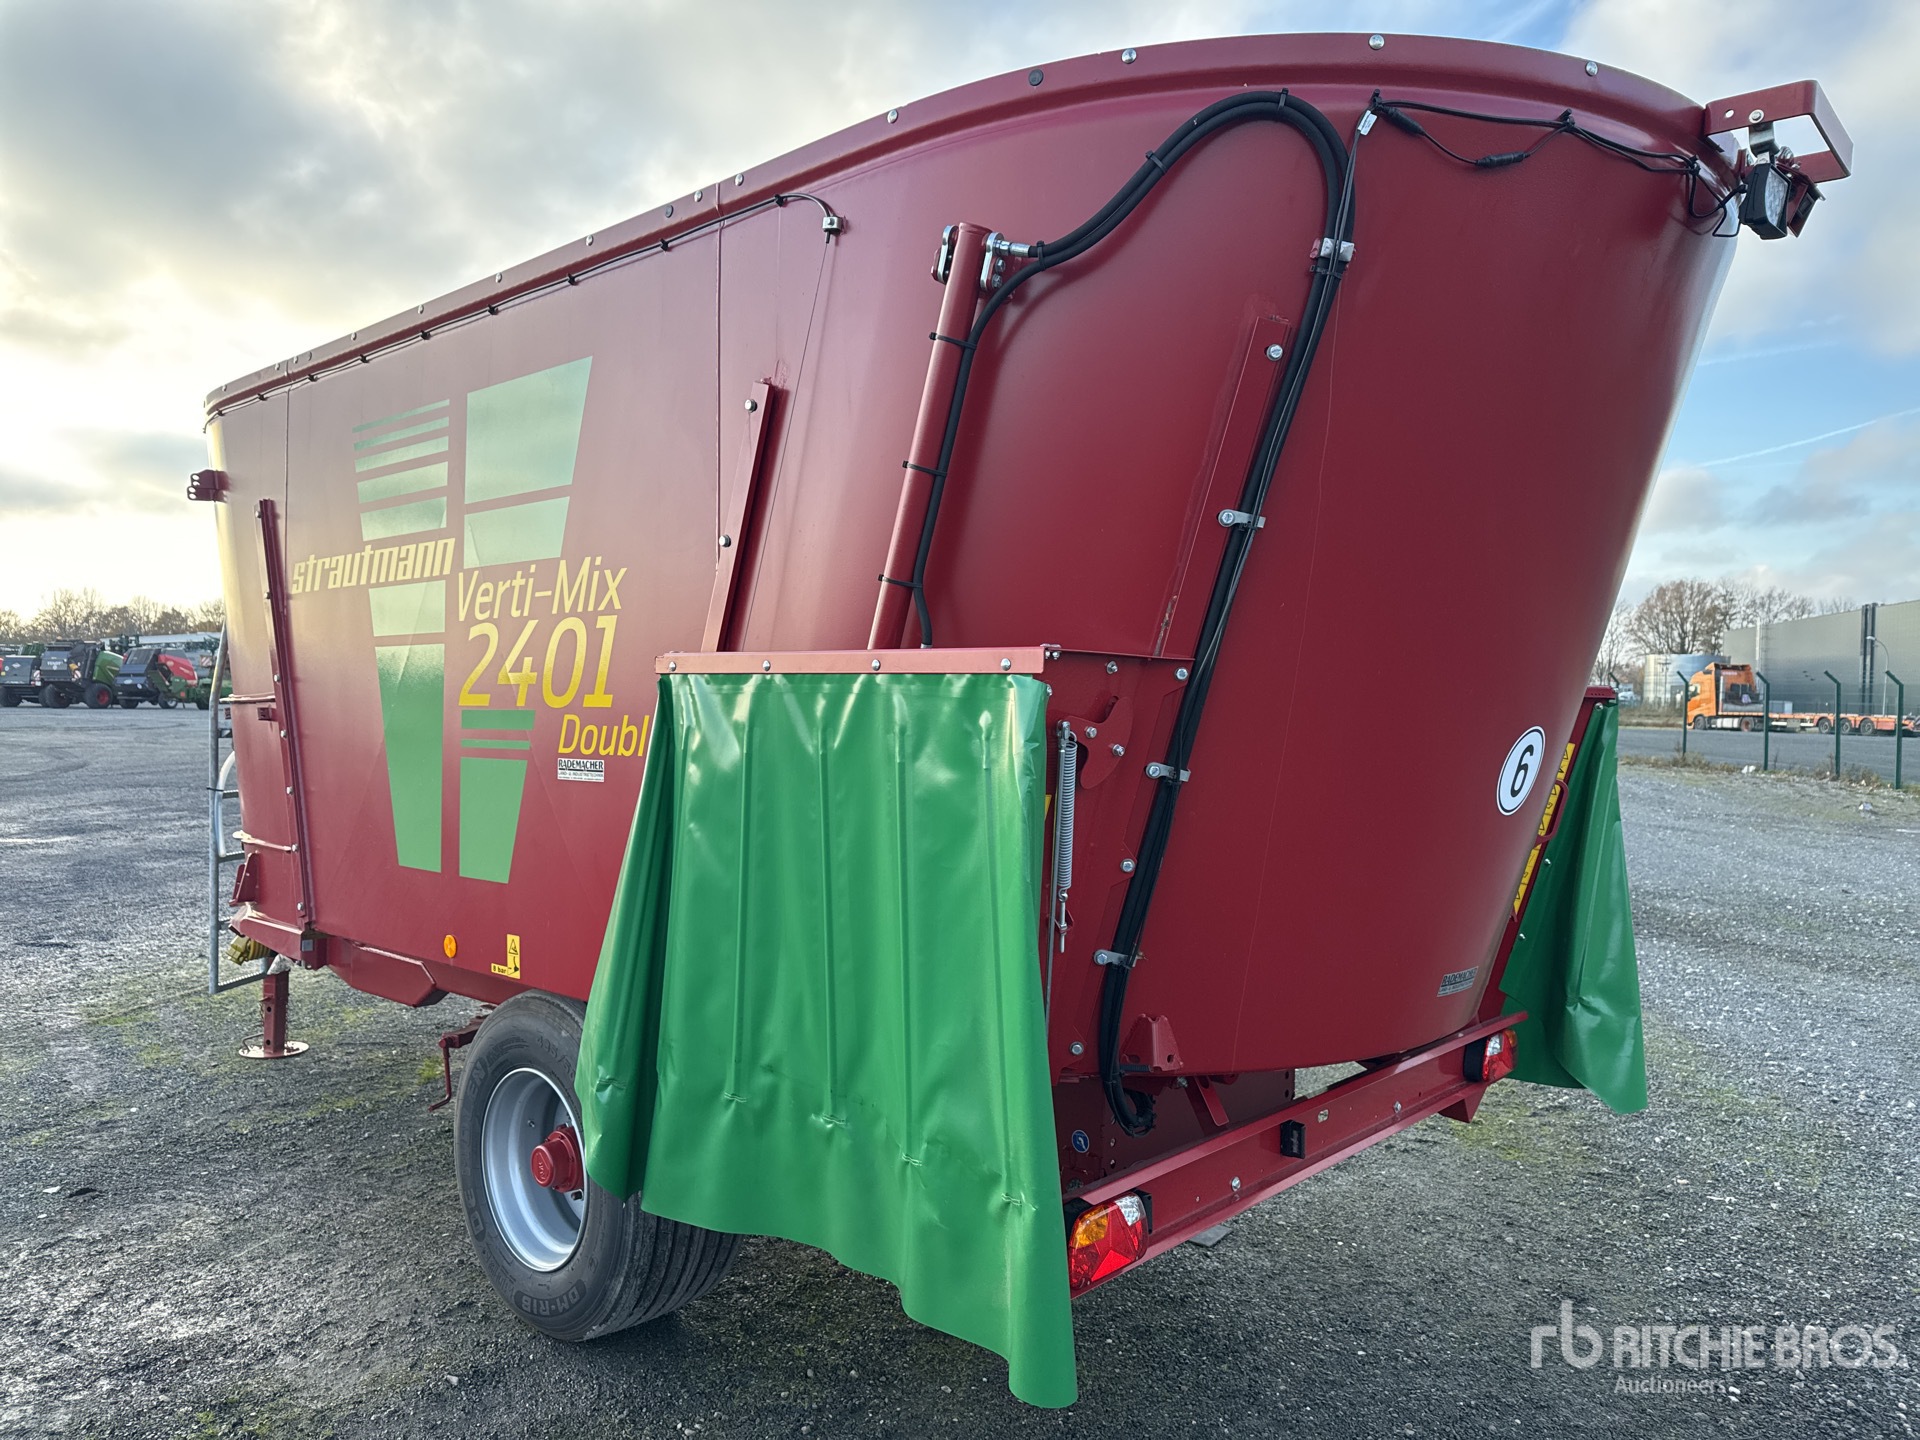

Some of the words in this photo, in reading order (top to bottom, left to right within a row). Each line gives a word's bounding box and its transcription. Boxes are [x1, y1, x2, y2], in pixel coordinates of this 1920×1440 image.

[291, 538, 456, 595] strautmann
[458, 555, 628, 622] Verti-Mix
[458, 614, 618, 709] 2401
[558, 759, 604, 770] RADEMACHER
[1510, 744, 1535, 798] 6
[497, 965, 506, 974] bar
